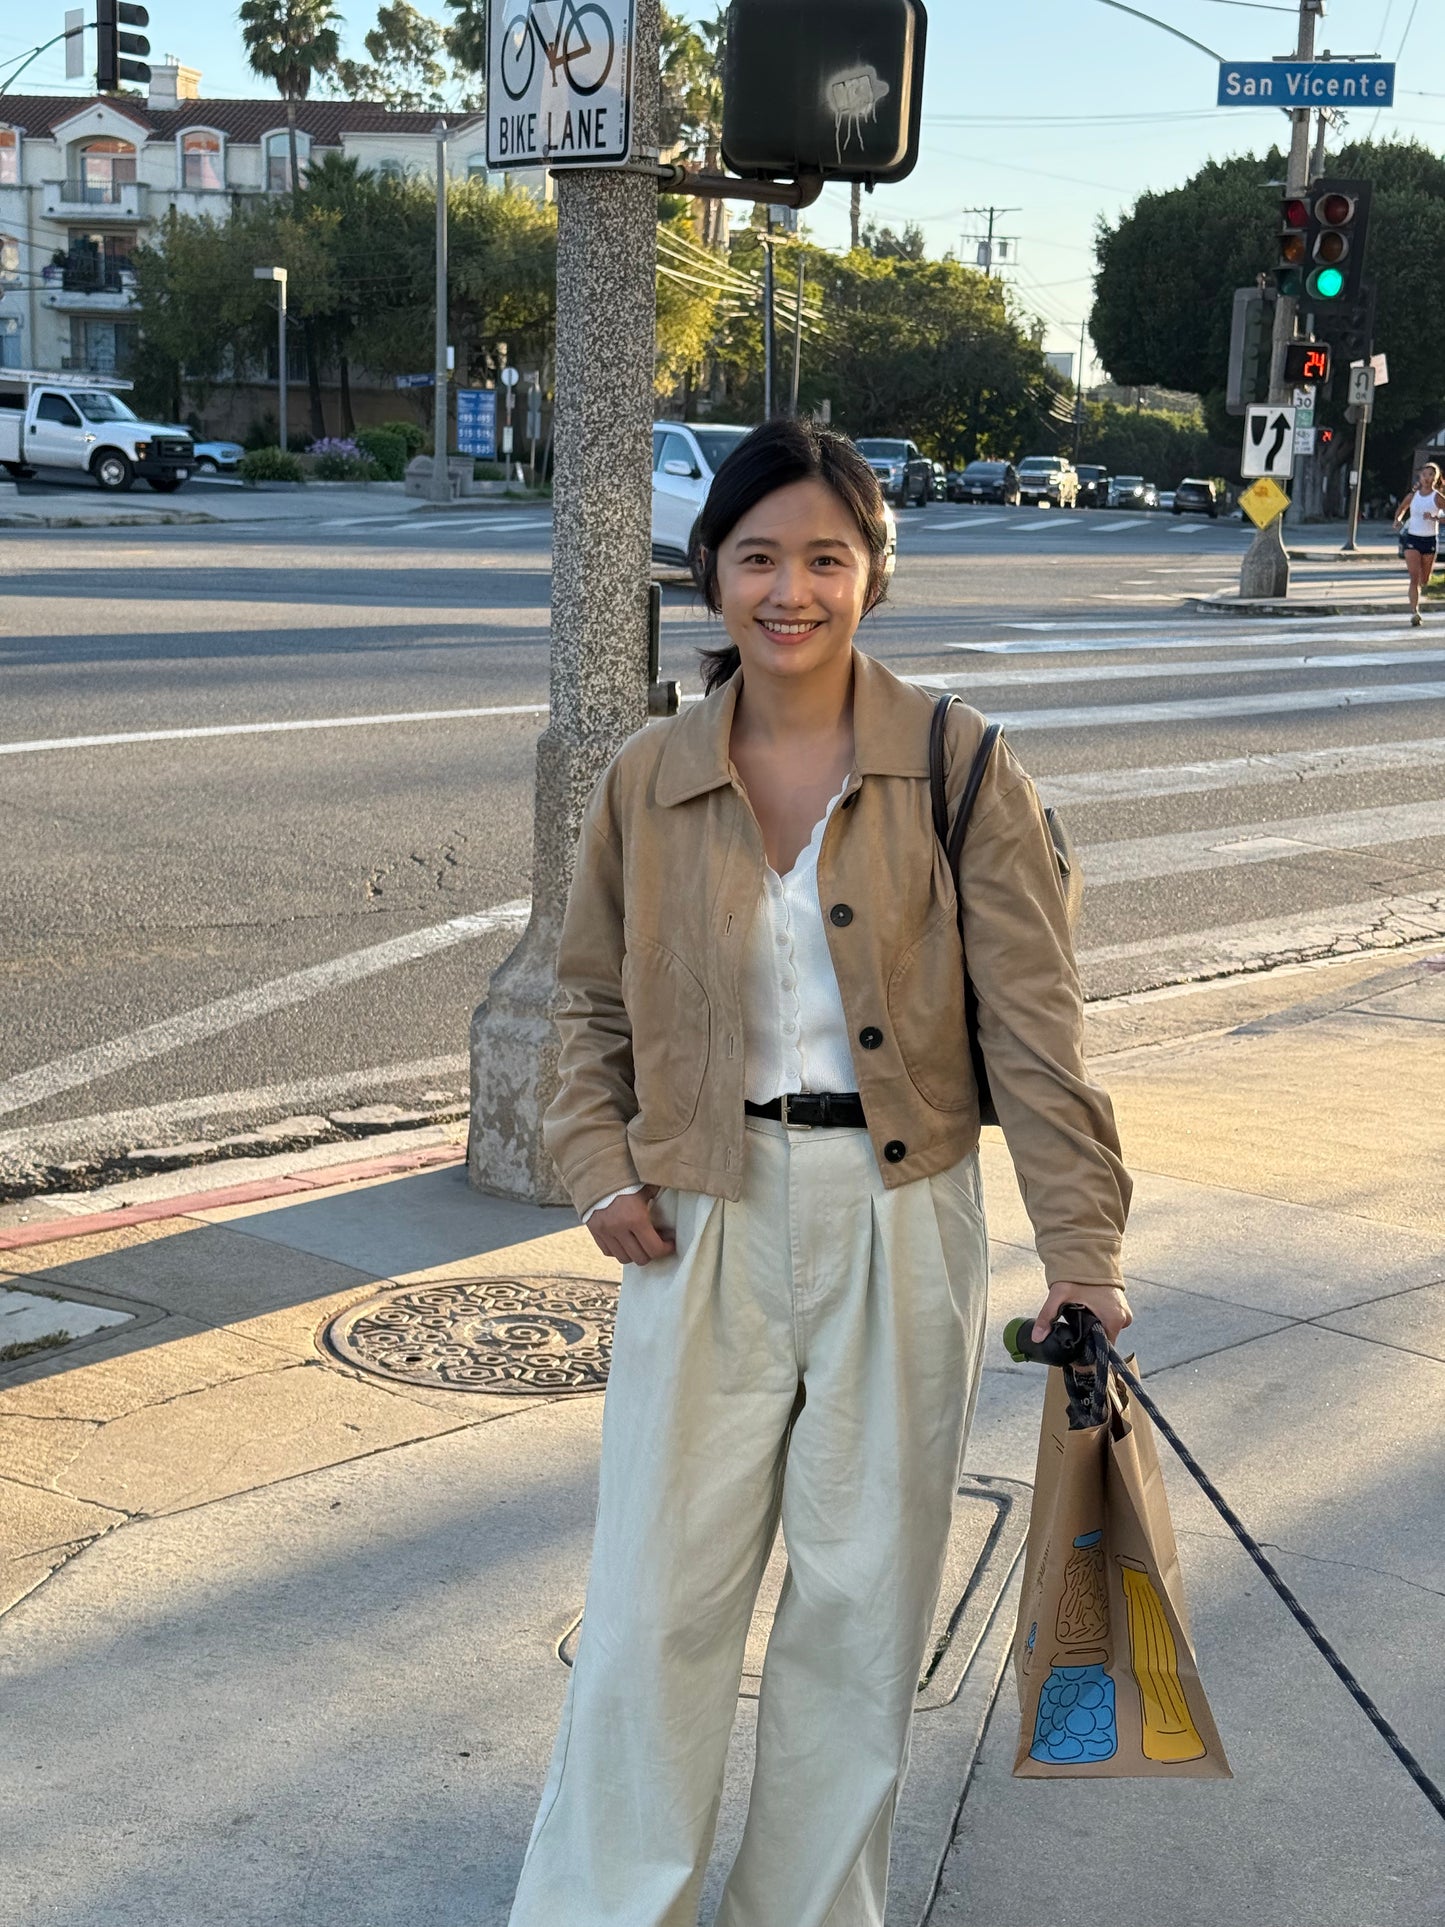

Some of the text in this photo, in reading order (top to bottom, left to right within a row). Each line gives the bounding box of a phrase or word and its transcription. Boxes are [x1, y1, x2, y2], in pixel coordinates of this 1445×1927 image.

[1226, 72, 1387, 97] San Vicente
[499, 113, 537, 155] BIKE
[547, 108, 607, 151] LANE
[1304, 351, 1325, 377] 24
[1296, 397, 1312, 408] 30
